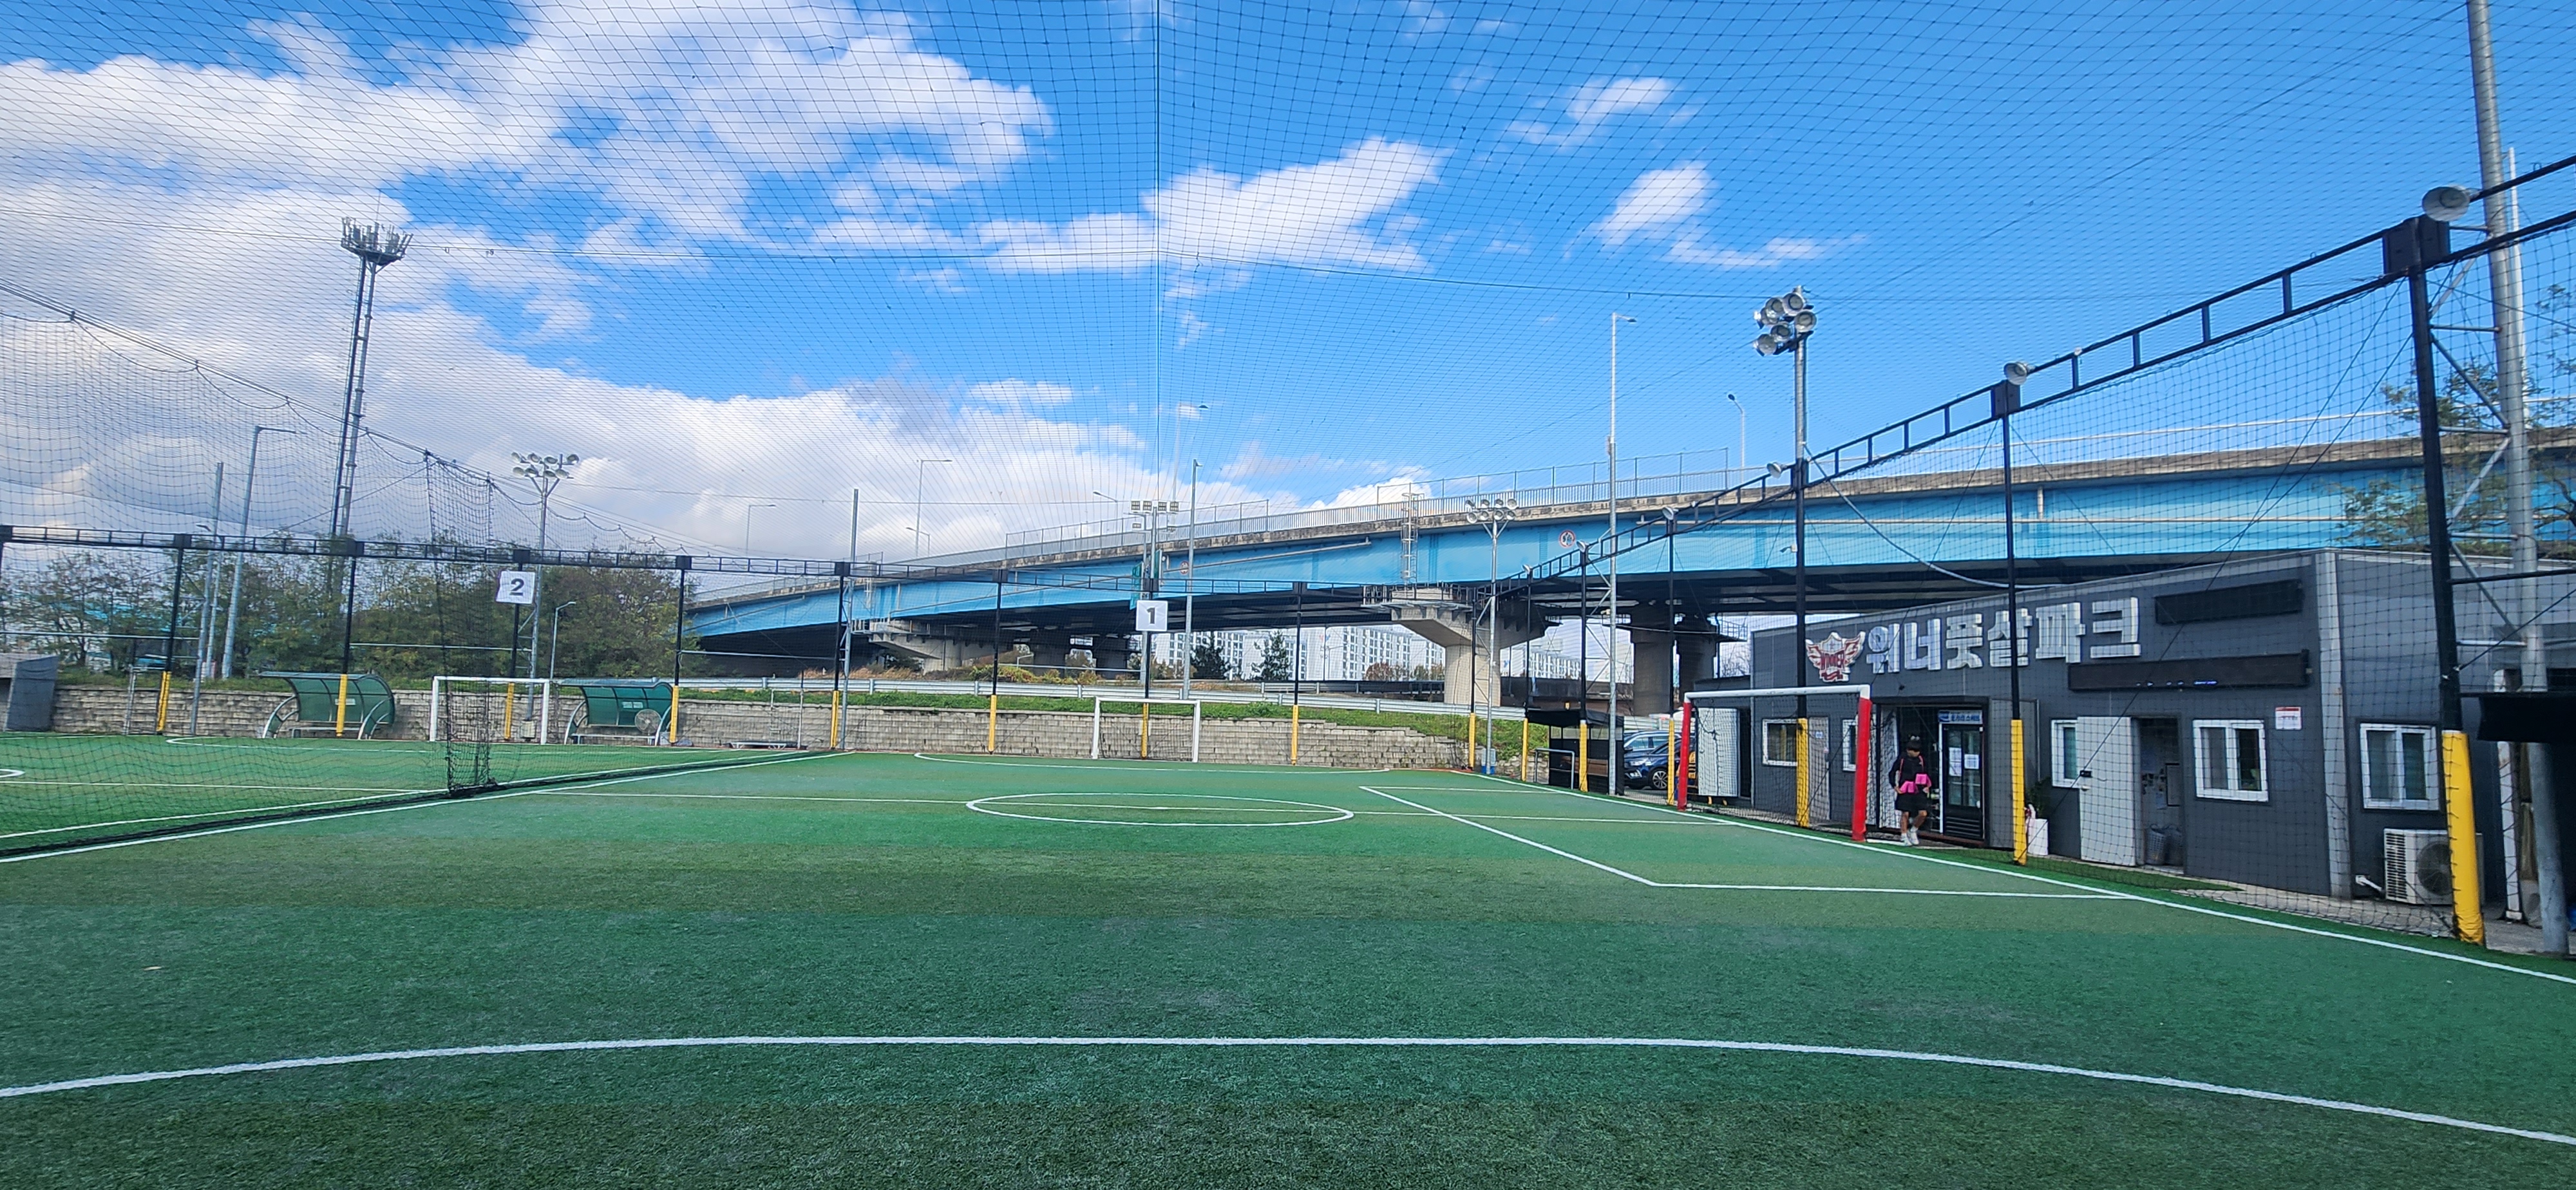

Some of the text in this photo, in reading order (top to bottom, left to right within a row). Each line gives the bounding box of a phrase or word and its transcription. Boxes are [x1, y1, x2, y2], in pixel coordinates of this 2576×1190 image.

[509, 578, 524, 596] 2
[1146, 607, 1155, 625] 1
[1866, 597, 2141, 674] 위너풋살파크
